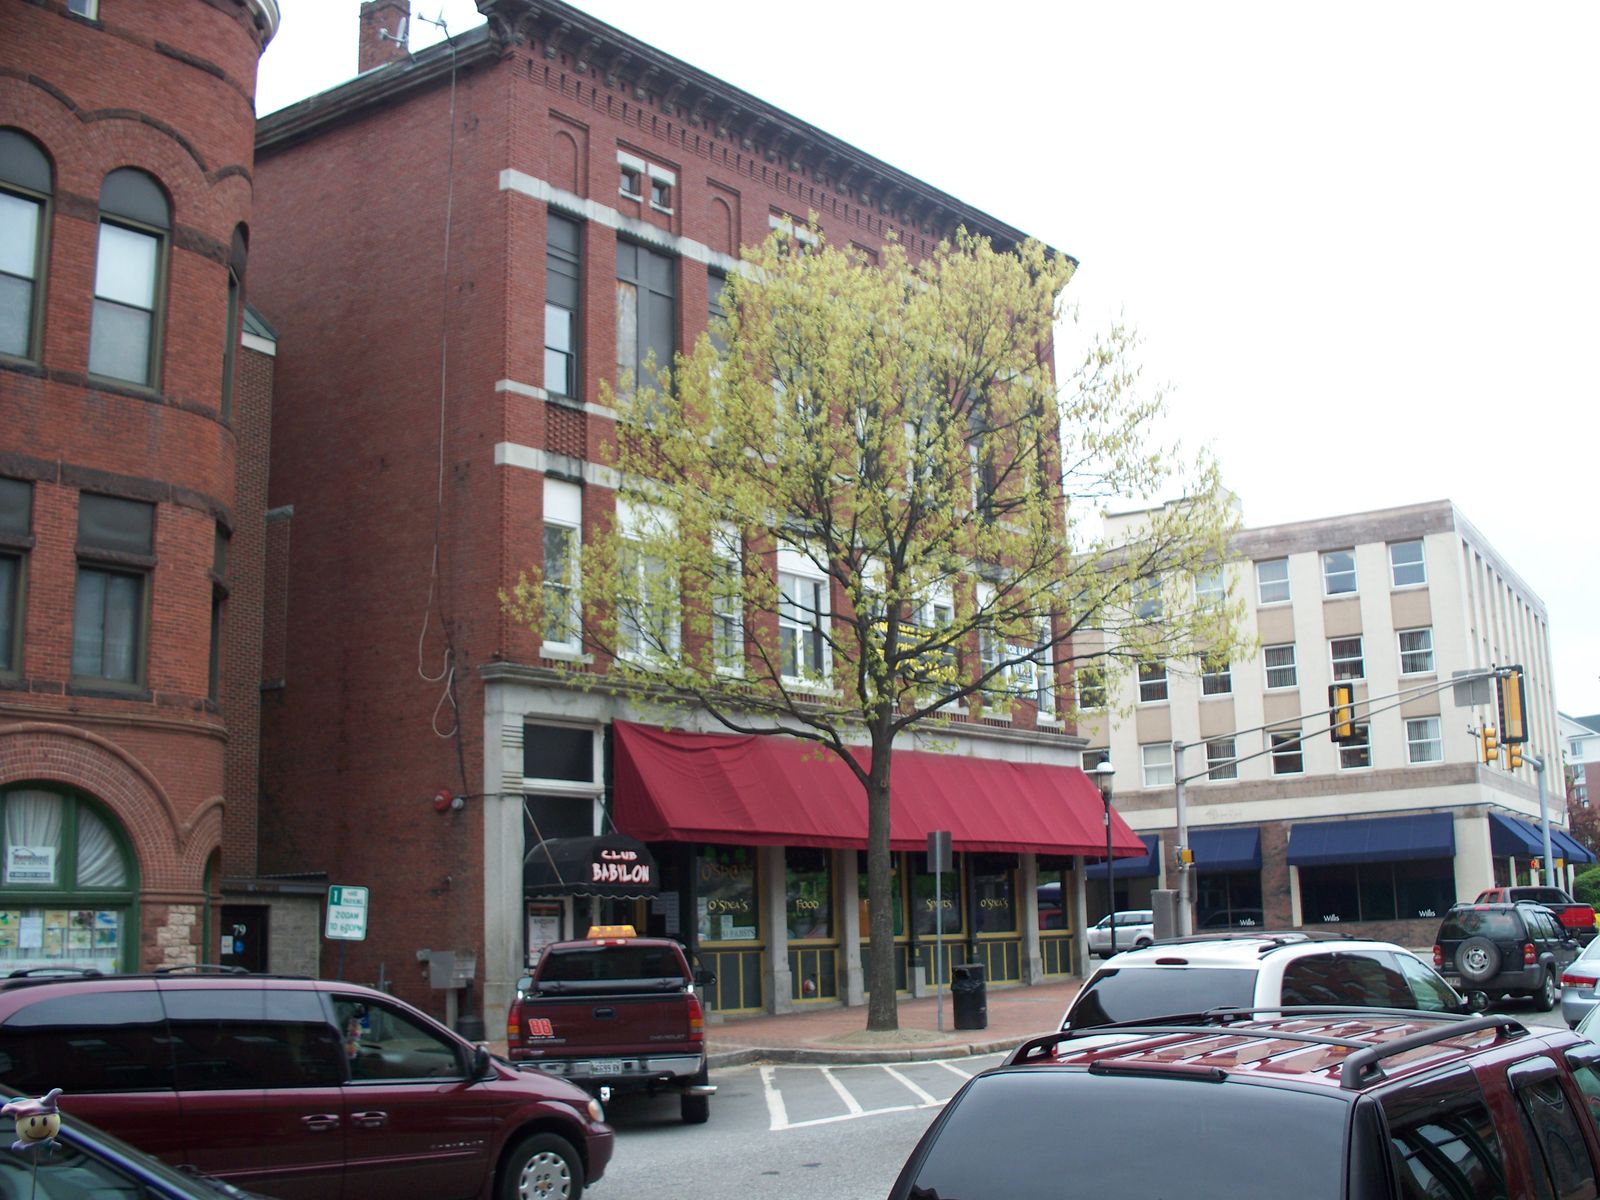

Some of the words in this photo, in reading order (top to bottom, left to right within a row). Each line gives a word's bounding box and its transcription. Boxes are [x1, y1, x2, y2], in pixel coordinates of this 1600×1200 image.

[601, 850, 638, 860] CLUB
[592, 863, 650, 883] BABYLON
[334, 890, 338, 903] 1
[1323, 913, 1340, 922] Willis
[1418, 909, 1436, 918] Willis
[1239, 918, 1255, 927] Willis
[233, 925, 247, 936] 79
[528, 1018, 553, 1036] 88
